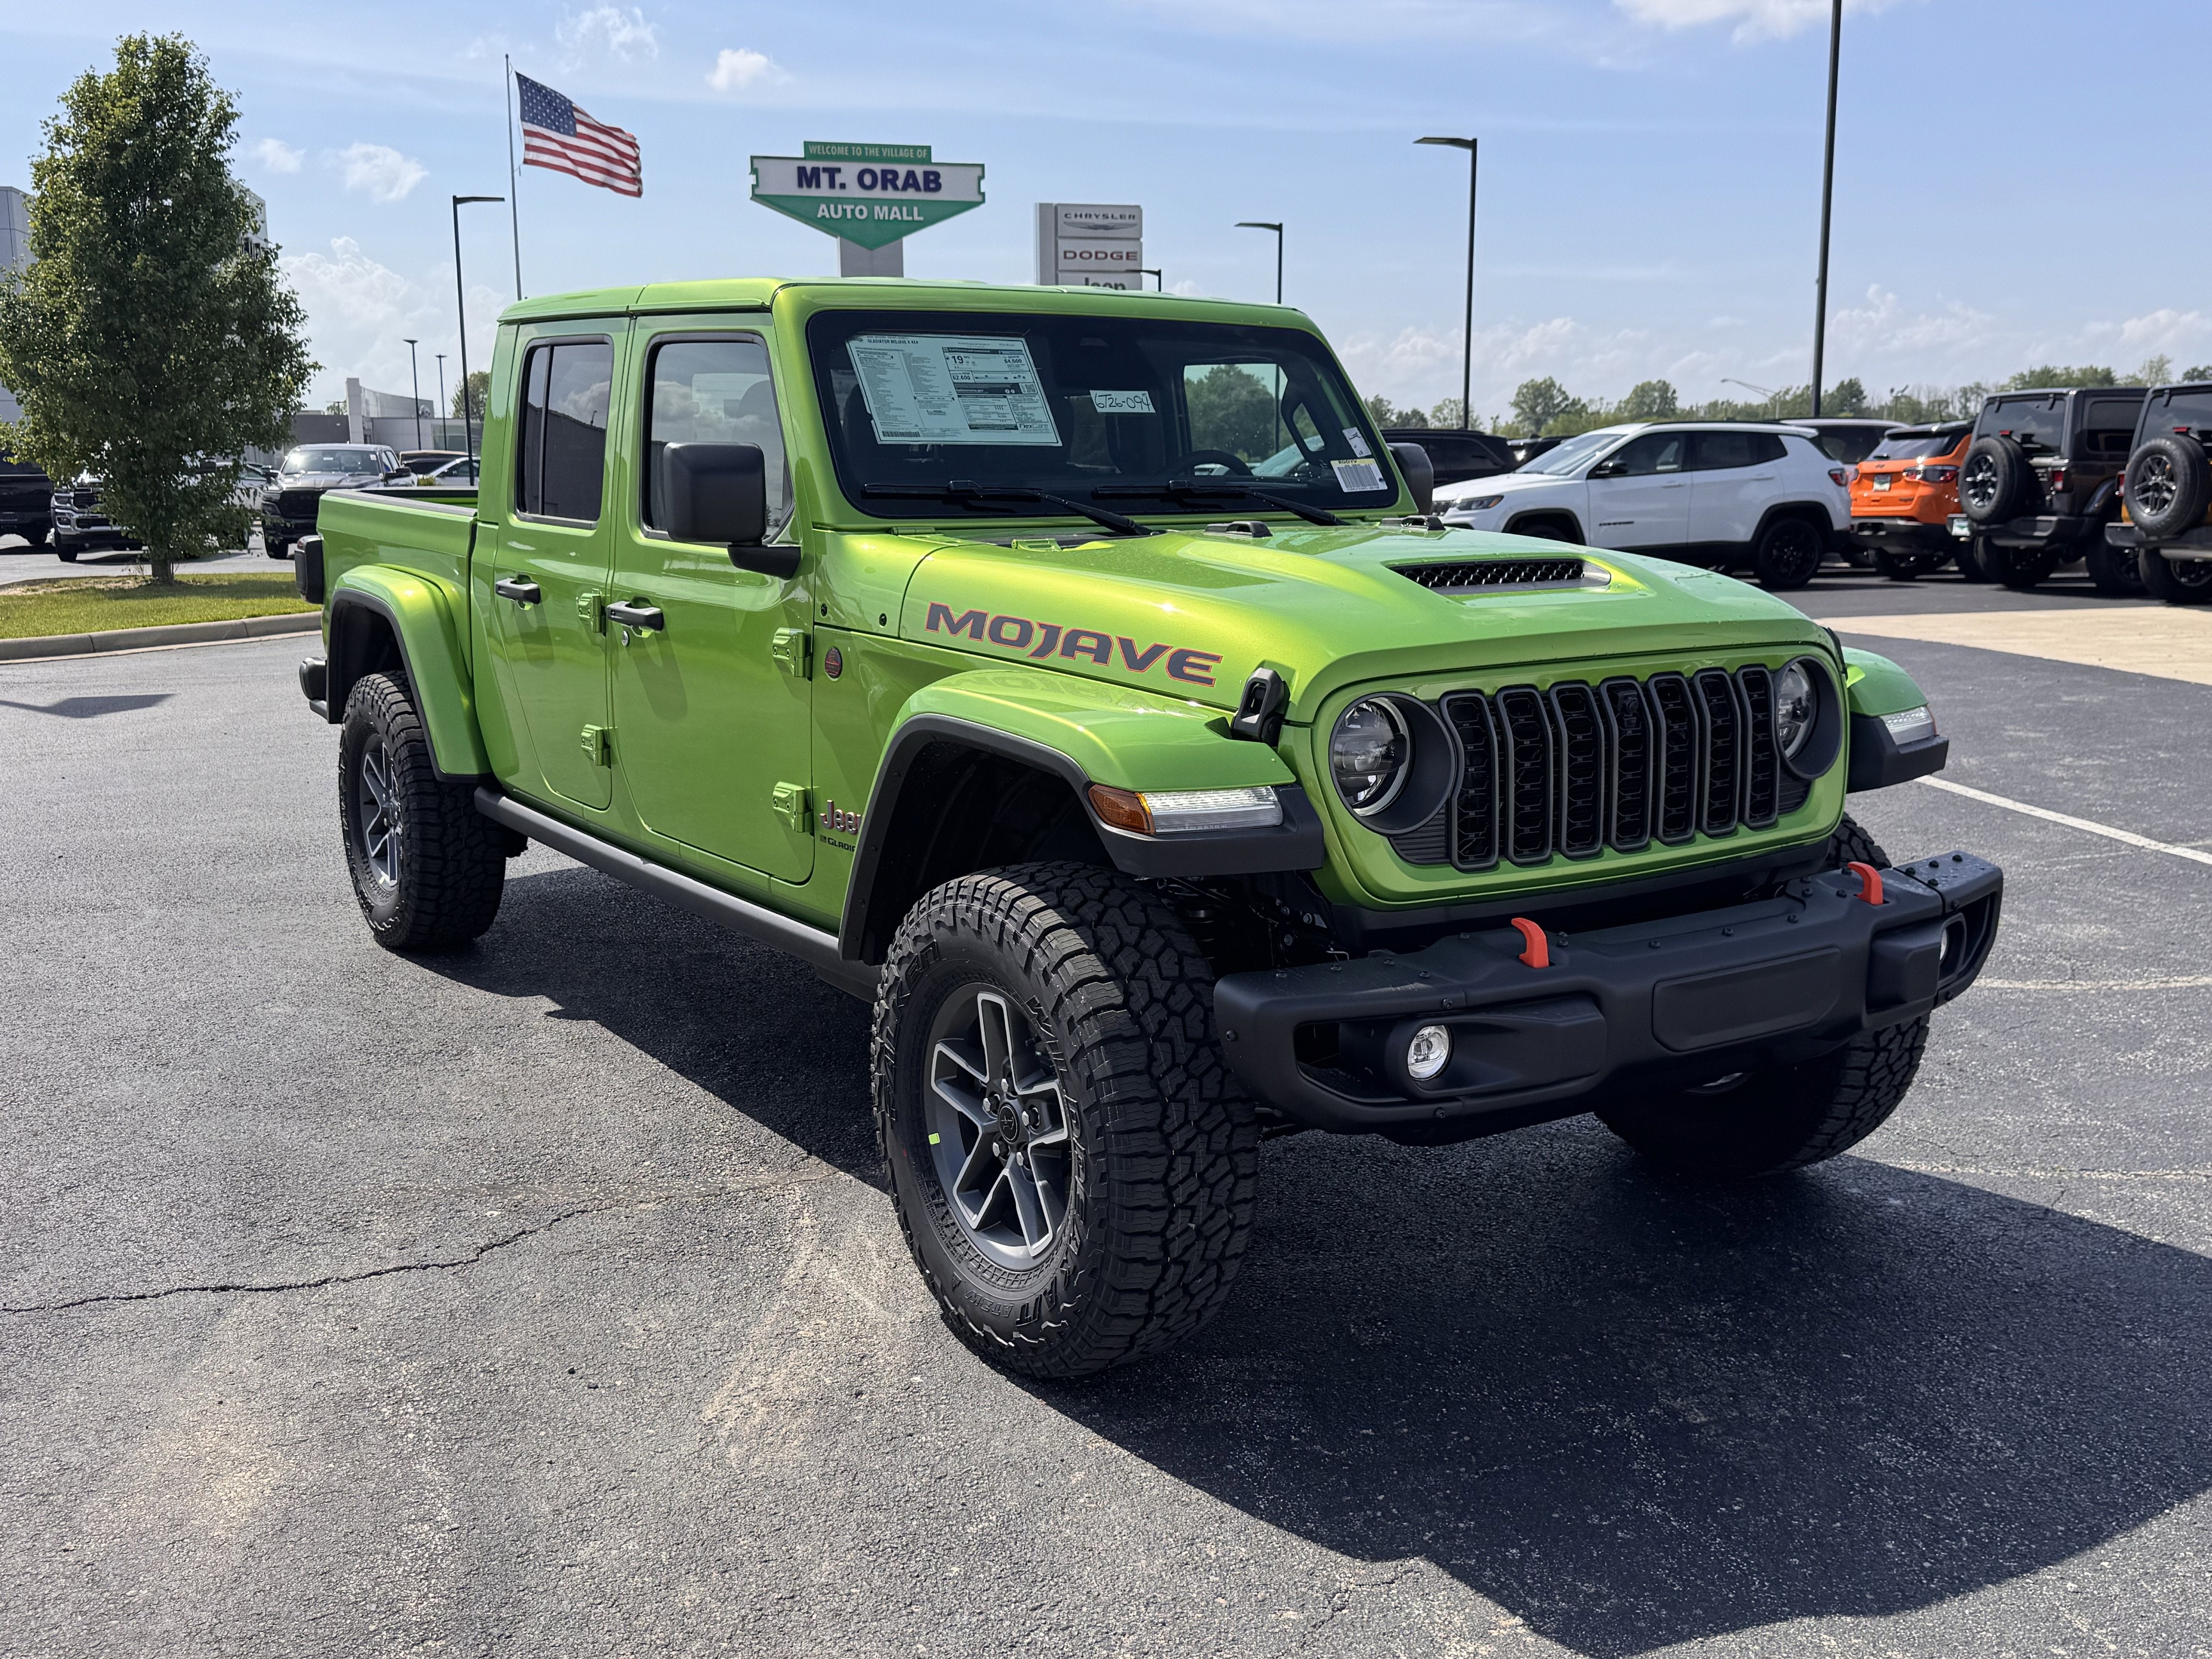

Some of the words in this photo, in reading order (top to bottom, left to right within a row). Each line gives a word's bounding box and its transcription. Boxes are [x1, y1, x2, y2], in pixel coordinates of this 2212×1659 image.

[809, 145, 849, 155] WELCOME
[851, 147, 862, 156] TO
[865, 147, 879, 156] THE
[882, 148, 914, 158] VILLAGE
[917, 149, 927, 158] OF
[797, 166, 846, 190] MT.
[857, 168, 942, 192] ORAB
[817, 204, 868, 220] AUTO
[874, 206, 924, 221] MALL
[1063, 250, 1138, 261] DODGE
[951, 356, 963, 364] 19
[924, 601, 1224, 687] MOJAVE
